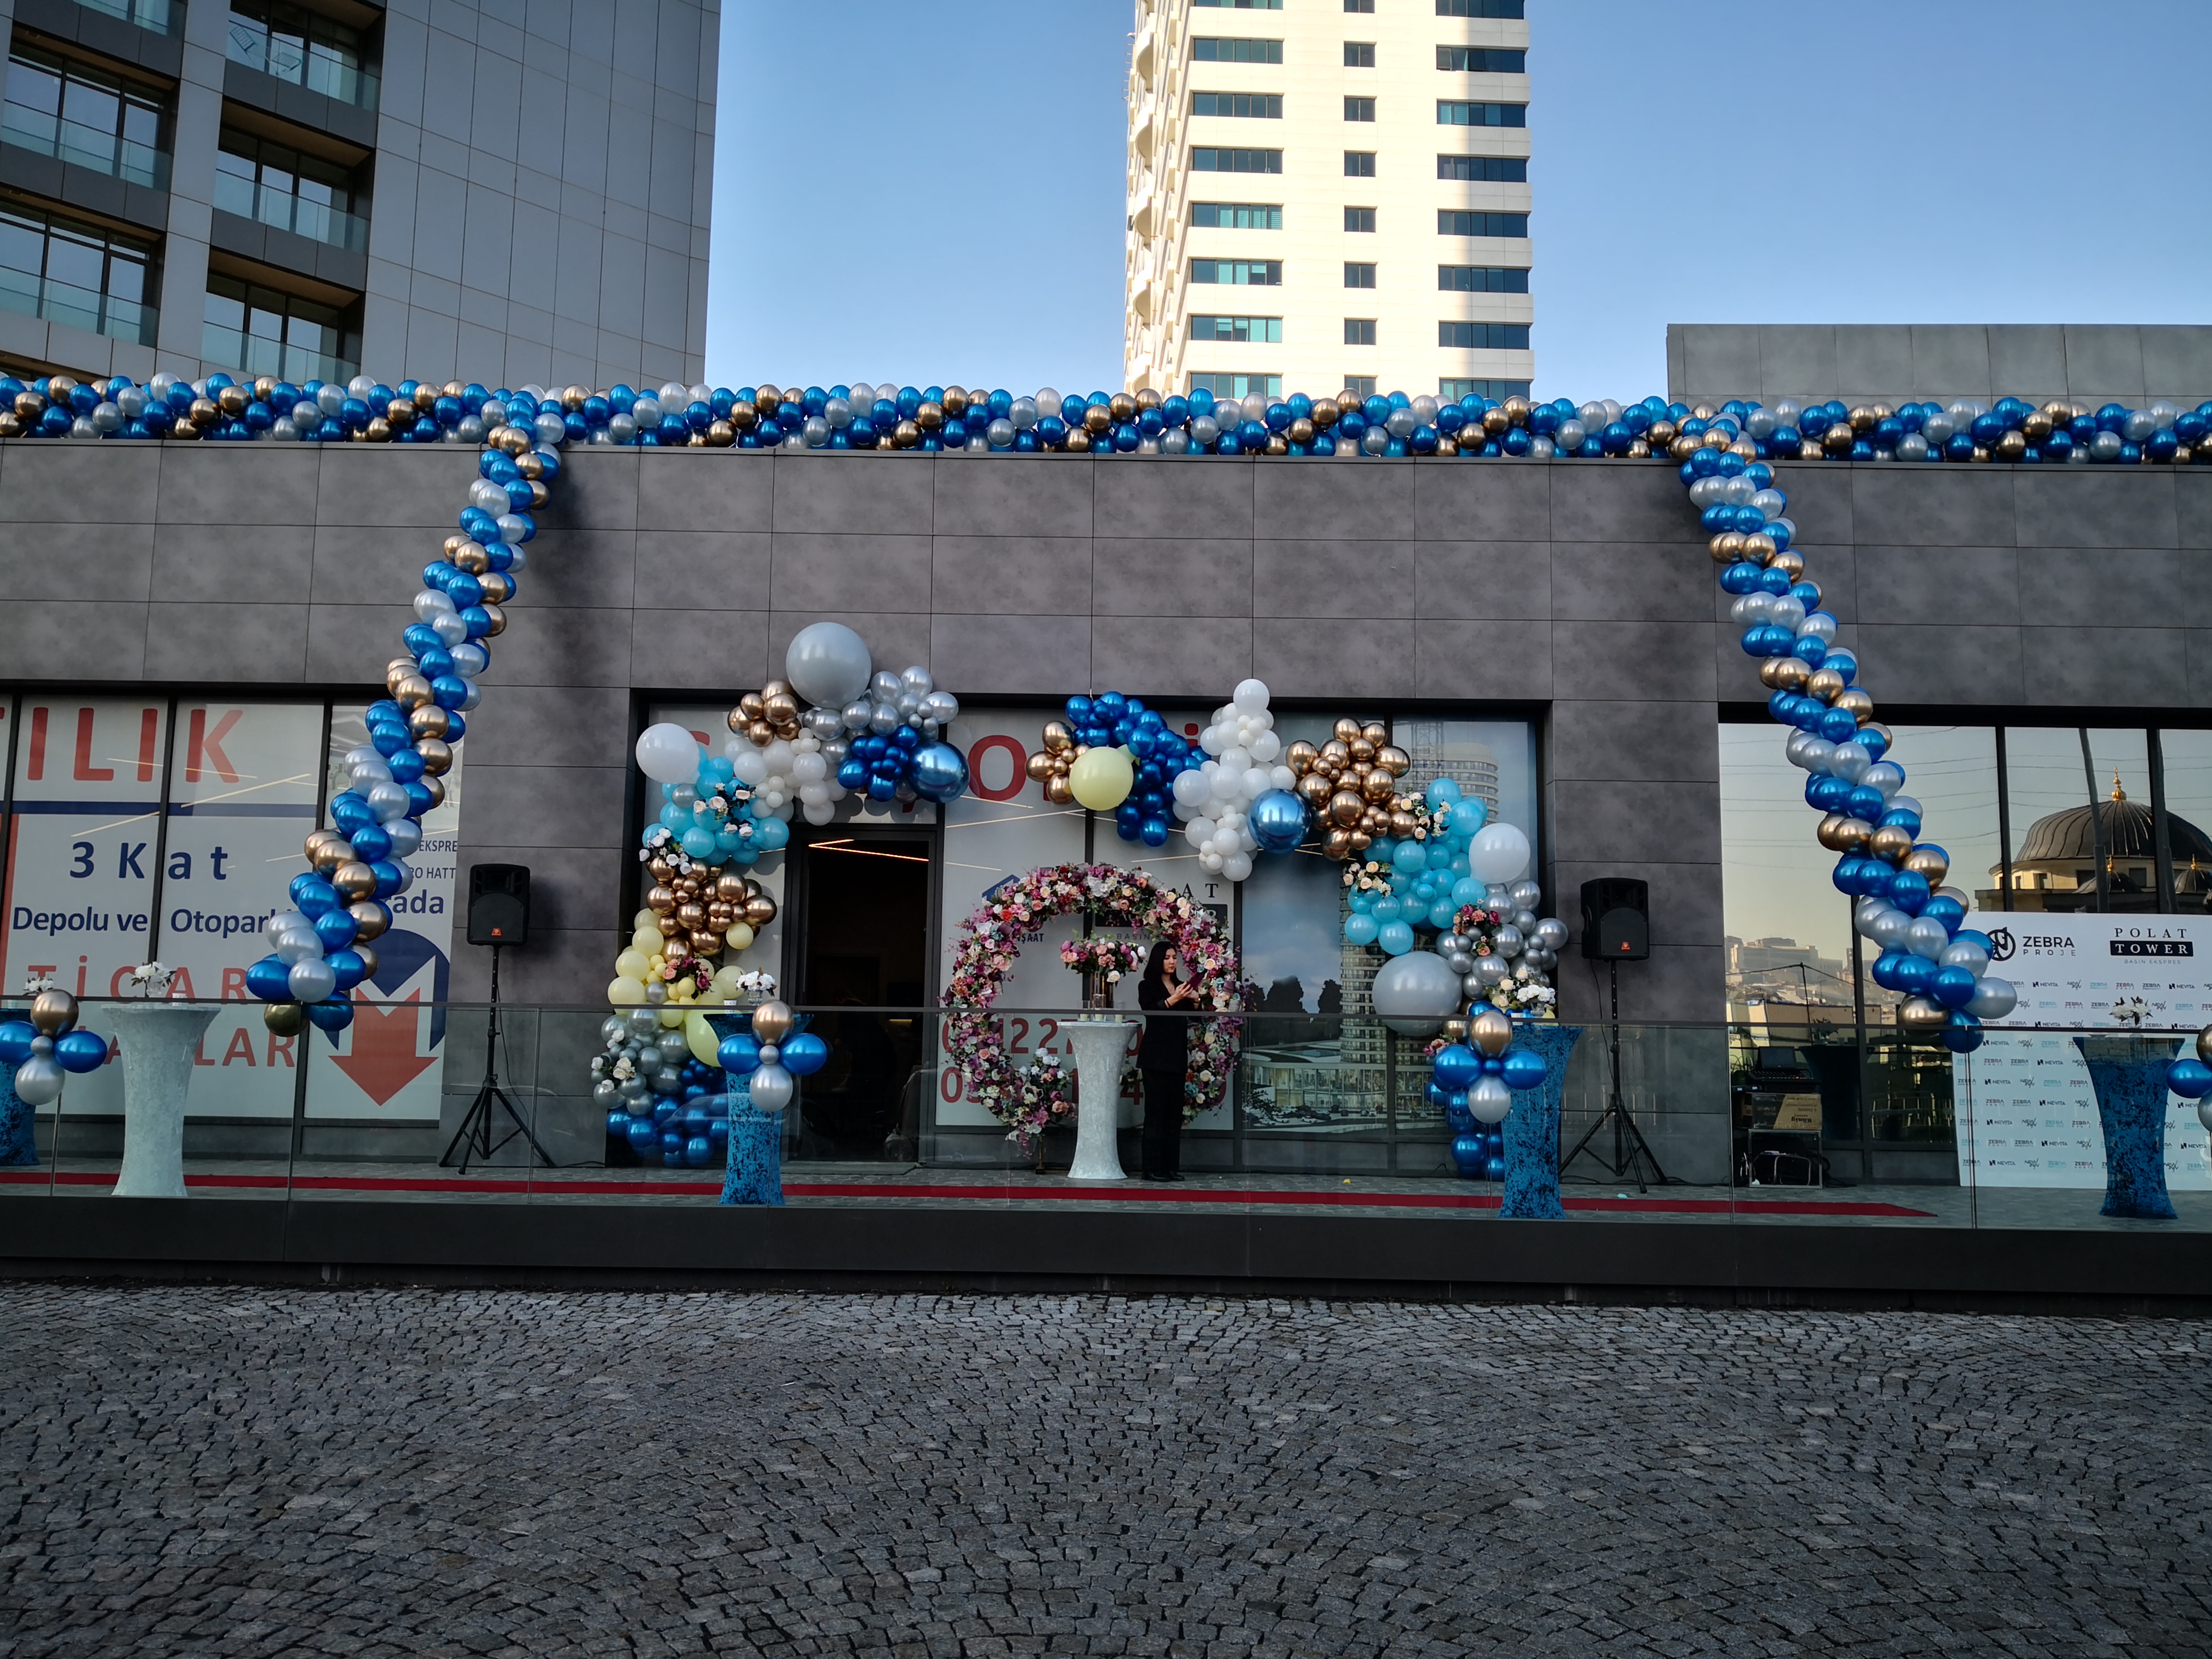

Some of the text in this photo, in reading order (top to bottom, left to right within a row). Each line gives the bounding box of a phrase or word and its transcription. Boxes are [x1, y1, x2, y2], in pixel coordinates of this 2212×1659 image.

[0, 707, 243, 783] ILIK
[70, 841, 228, 880] 3 Kat
[13, 906, 109, 937] Depolu
[117, 913, 148, 932] ve
[2023, 936, 2075, 948] ZEBRA
[2114, 928, 2187, 938] POLAT
[2115, 944, 2188, 954] TOWER
